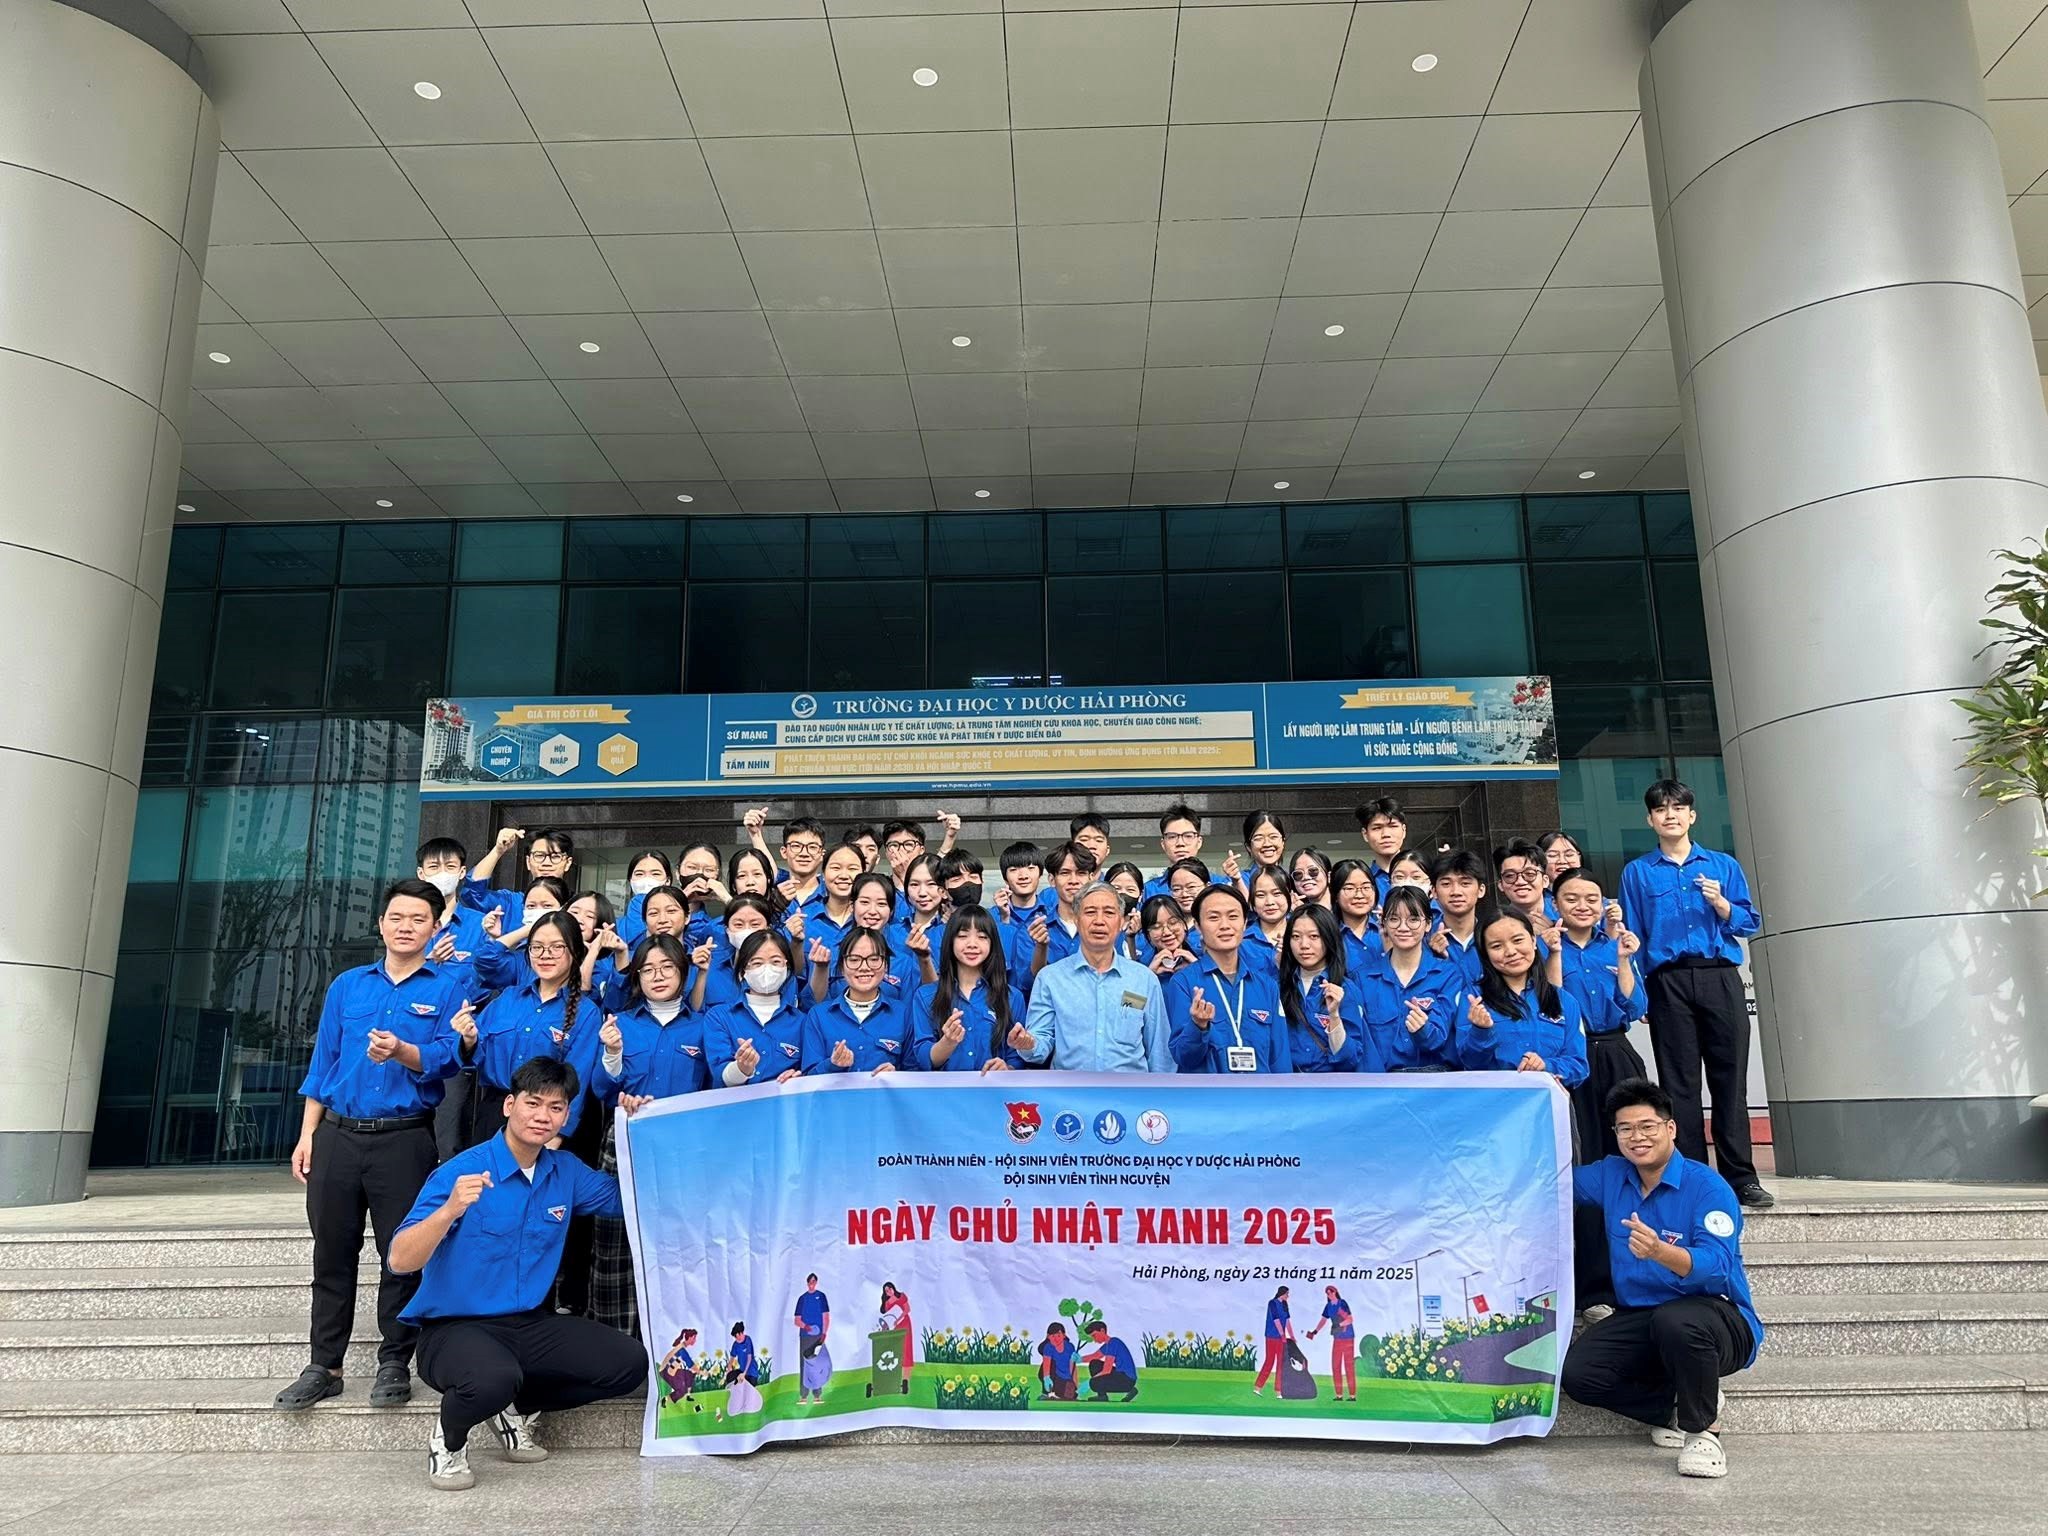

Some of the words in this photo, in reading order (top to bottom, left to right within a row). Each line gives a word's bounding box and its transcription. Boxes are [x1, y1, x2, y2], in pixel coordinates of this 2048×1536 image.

[833, 696, 913, 714] TRƯỜNG
[918, 698, 952, 715] ĐẠI
[957, 697, 999, 715] HỌC
[1004, 697, 1016, 710] Y
[1021, 695, 1075, 713] DƯỢC
[1080, 691, 1114, 709] HẢI
[1119, 690, 1187, 708] PHÒNG
[727, 730, 740, 741] SỨ
[741, 731, 768, 742] MẠNG
[1283, 721, 1298, 738] LẤY
[1299, 721, 1322, 737] NGƯỜI
[1324, 723, 1340, 739] HỌC
[1341, 721, 1358, 736] LÀM
[1359, 722, 1385, 736] TRUNG
[1386, 720, 1403, 735] TÂM
[1410, 718, 1425, 735] LẤY
[1426, 719, 1450, 734] NGƯỜI
[1493, 719, 1518, 733] TRUNG
[554, 744, 566, 755] HỘI
[1364, 741, 1373, 756] VÌ
[1374, 741, 1389, 756] SỨC
[1391, 739, 1411, 756] KHỎE
[1413, 741, 1434, 758] CỘNG
[747, 760, 770, 769] NHÌN
[878, 1154, 912, 1167] ĐOÀN
[915, 1153, 955, 1167] THÀNH
[957, 1155, 986, 1167] NIÊN
[995, 1154, 1017, 1169] HỘI
[1019, 1156, 1047, 1166] SINH
[1049, 1153, 1078, 1166] VIÊN
[1080, 1153, 1131, 1167] TRƯỜNG
[1133, 1156, 1155, 1170] ĐẠI
[1157, 1156, 1183, 1170] HỌC
[1185, 1156, 1194, 1167] Y
[1196, 1155, 1231, 1170] DƯỢC
[1233, 1153, 1255, 1167] HẢI
[1257, 1154, 1301, 1167] PHÒNG
[1004, 1172, 1025, 1188] ĐỘI
[1027, 1174, 1056, 1185] SINH
[1058, 1172, 1087, 1185] VIÊN
[1089, 1172, 1118, 1185] TÌNH
[1120, 1172, 1170, 1188] NGUYỆN
[847, 1200, 936, 1245] NGÀY
[949, 1199, 1018, 1243] CHỦ
[1032, 1201, 1123, 1251] NHẬT
[1136, 1208, 1229, 1245] XANH
[1243, 1207, 1336, 1245] 2025
[1132, 1266, 1157, 1278] Hải
[1160, 1266, 1210, 1281] Phòng,
[1214, 1266, 1250, 1282] ngày
[1252, 1266, 1271, 1279] 23
[1274, 1266, 1317, 1282] tháng
[1319, 1267, 1335, 1279] 11
[1339, 1266, 1372, 1280] năm
[1376, 1268, 1413, 1280] 2025
